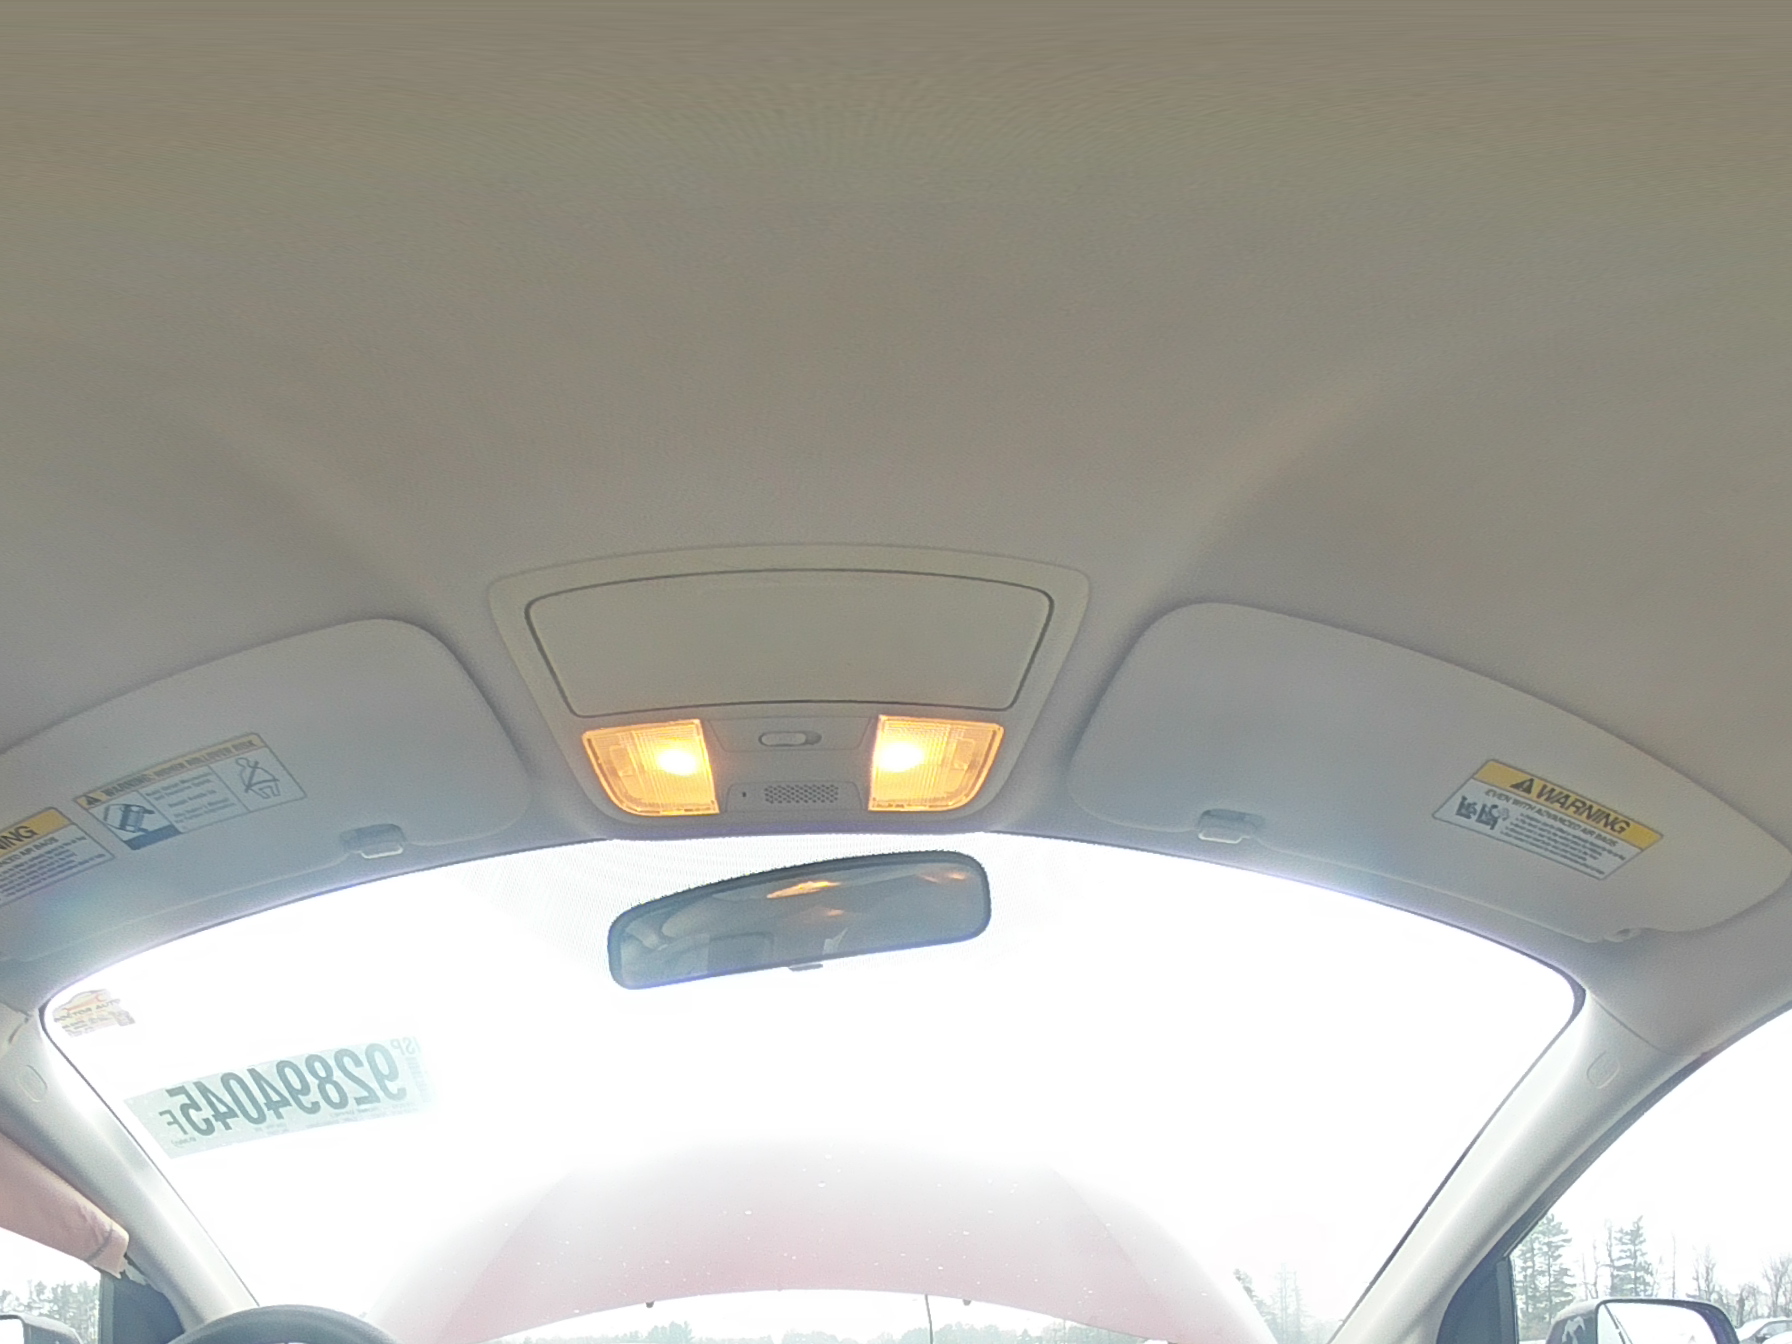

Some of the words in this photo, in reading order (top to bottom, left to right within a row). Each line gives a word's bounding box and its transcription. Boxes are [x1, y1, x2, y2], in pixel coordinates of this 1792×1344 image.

[1484, 788, 1512, 803] EVEN
[1511, 798, 1536, 812] WITH
[1535, 808, 1582, 831] ADVANCED
[1580, 826, 1597, 838] AIR
[1595, 832, 1618, 848] BAGS
[1536, 784, 1631, 835] WARNING
